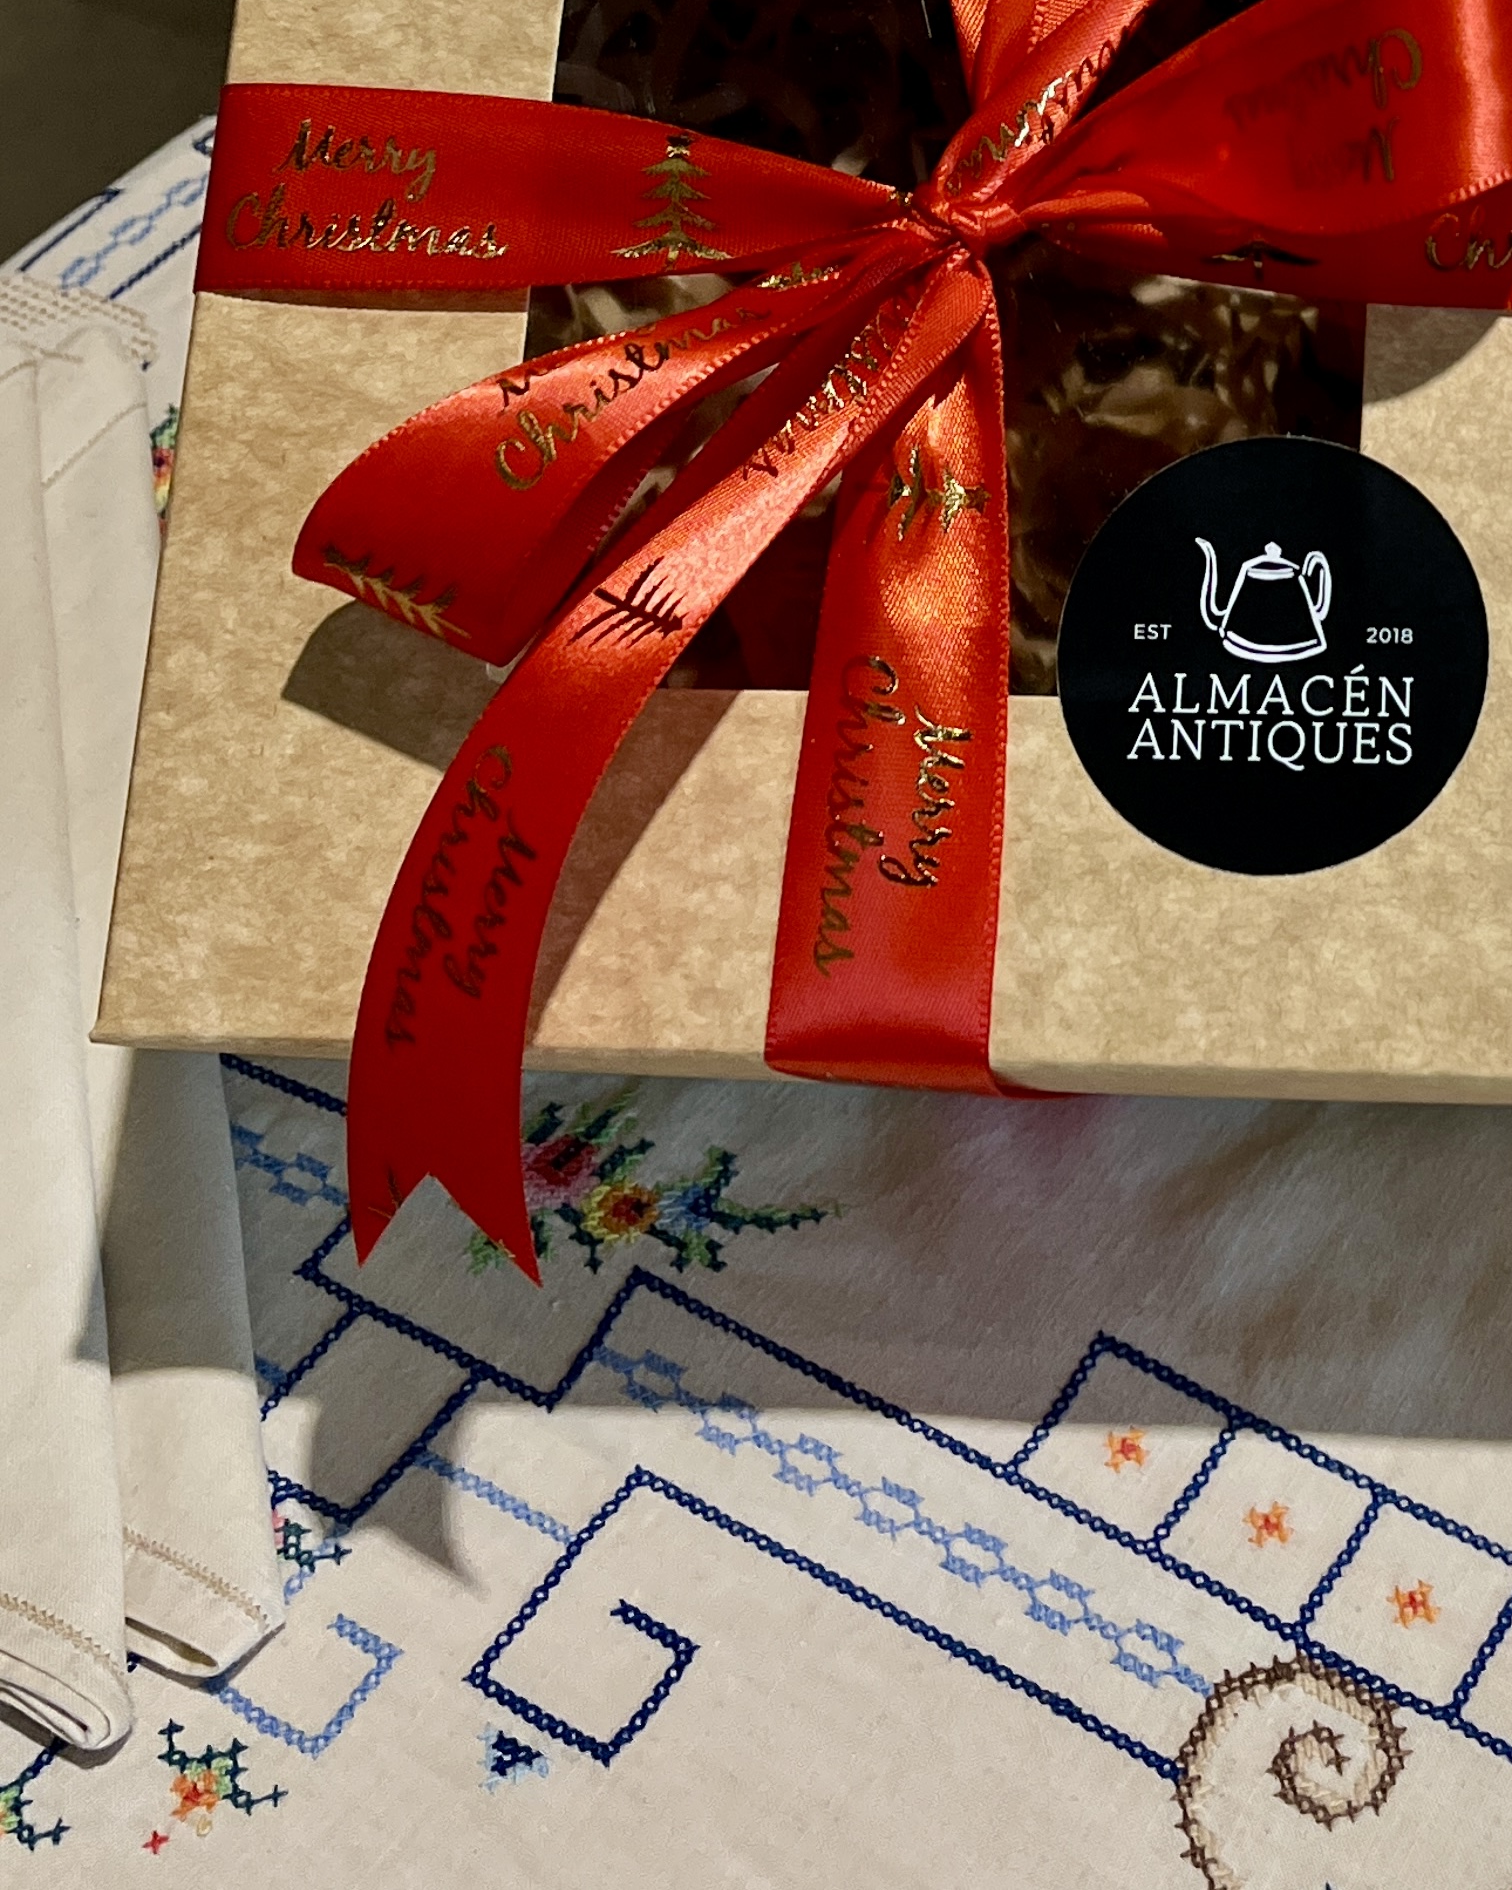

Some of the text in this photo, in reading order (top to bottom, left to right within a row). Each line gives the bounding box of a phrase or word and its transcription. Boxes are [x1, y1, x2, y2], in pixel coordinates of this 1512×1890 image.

[273, 116, 437, 203] Merry
[226, 183, 510, 259] Christmas
[1133, 623, 1414, 645] EST 2018
[1128, 663, 1415, 718] ALMACÉN
[1126, 718, 1413, 772] ANTIQUES
[813, 653, 907, 979] Christmas
[879, 704, 974, 889] Merry
[384, 743, 512, 1052] Christmas
[442, 808, 539, 1000] Merry
